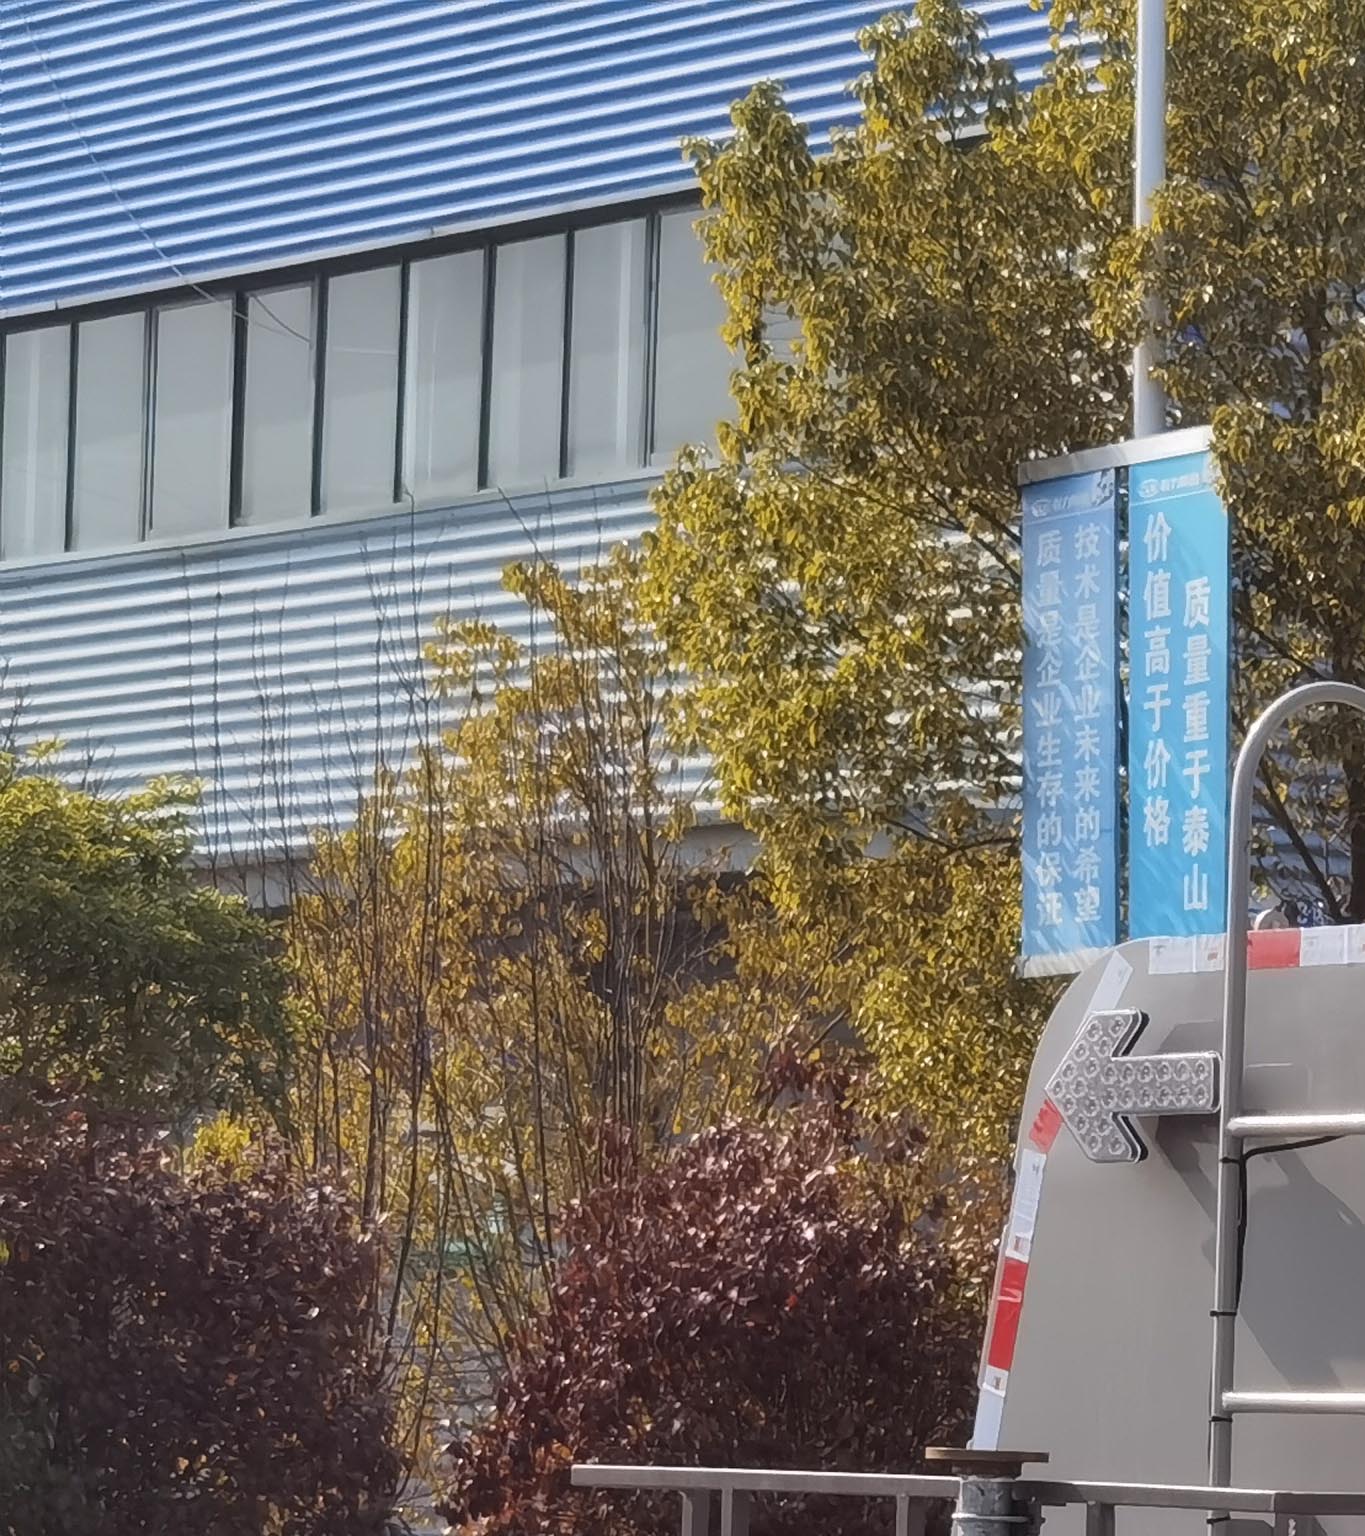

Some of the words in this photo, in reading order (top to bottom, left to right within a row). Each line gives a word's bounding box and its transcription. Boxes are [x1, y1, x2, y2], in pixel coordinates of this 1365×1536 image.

[1035, 528, 1063, 927] 质量是企业生存的保证
[1073, 522, 1102, 924] 技术是企业未来的希望
[1143, 511, 1172, 848] 价值高于价格
[1182, 575, 1212, 913] 质量重于泰山
